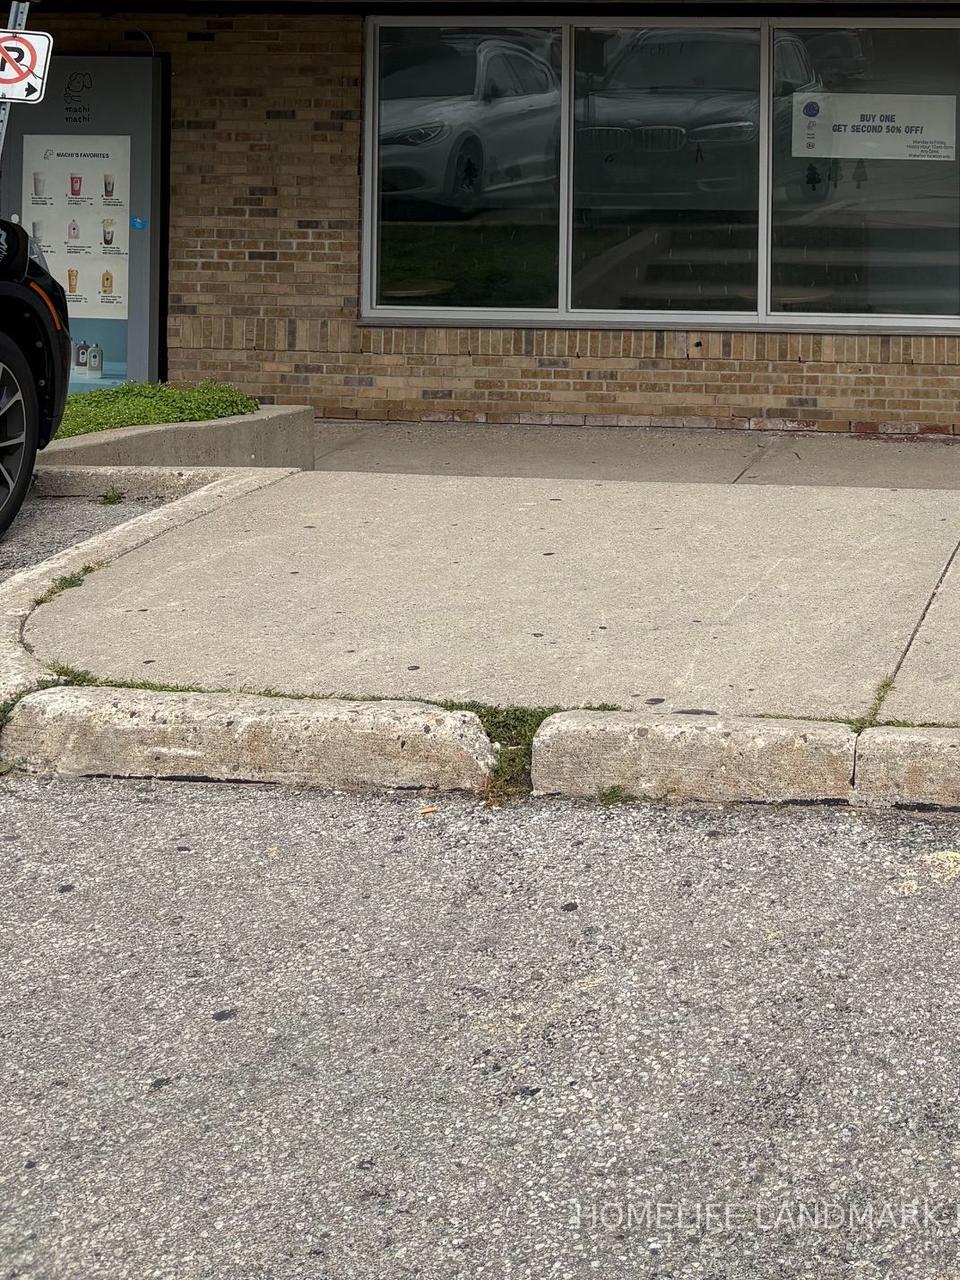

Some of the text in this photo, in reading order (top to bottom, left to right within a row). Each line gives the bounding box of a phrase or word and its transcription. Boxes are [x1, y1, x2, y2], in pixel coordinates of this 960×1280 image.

[64, 103, 90, 114] machi
[64, 113, 90, 124] machi
[859, 113, 896, 123] BUY ONE
[831, 123, 924, 135] GET SECOND 50% OFF!
